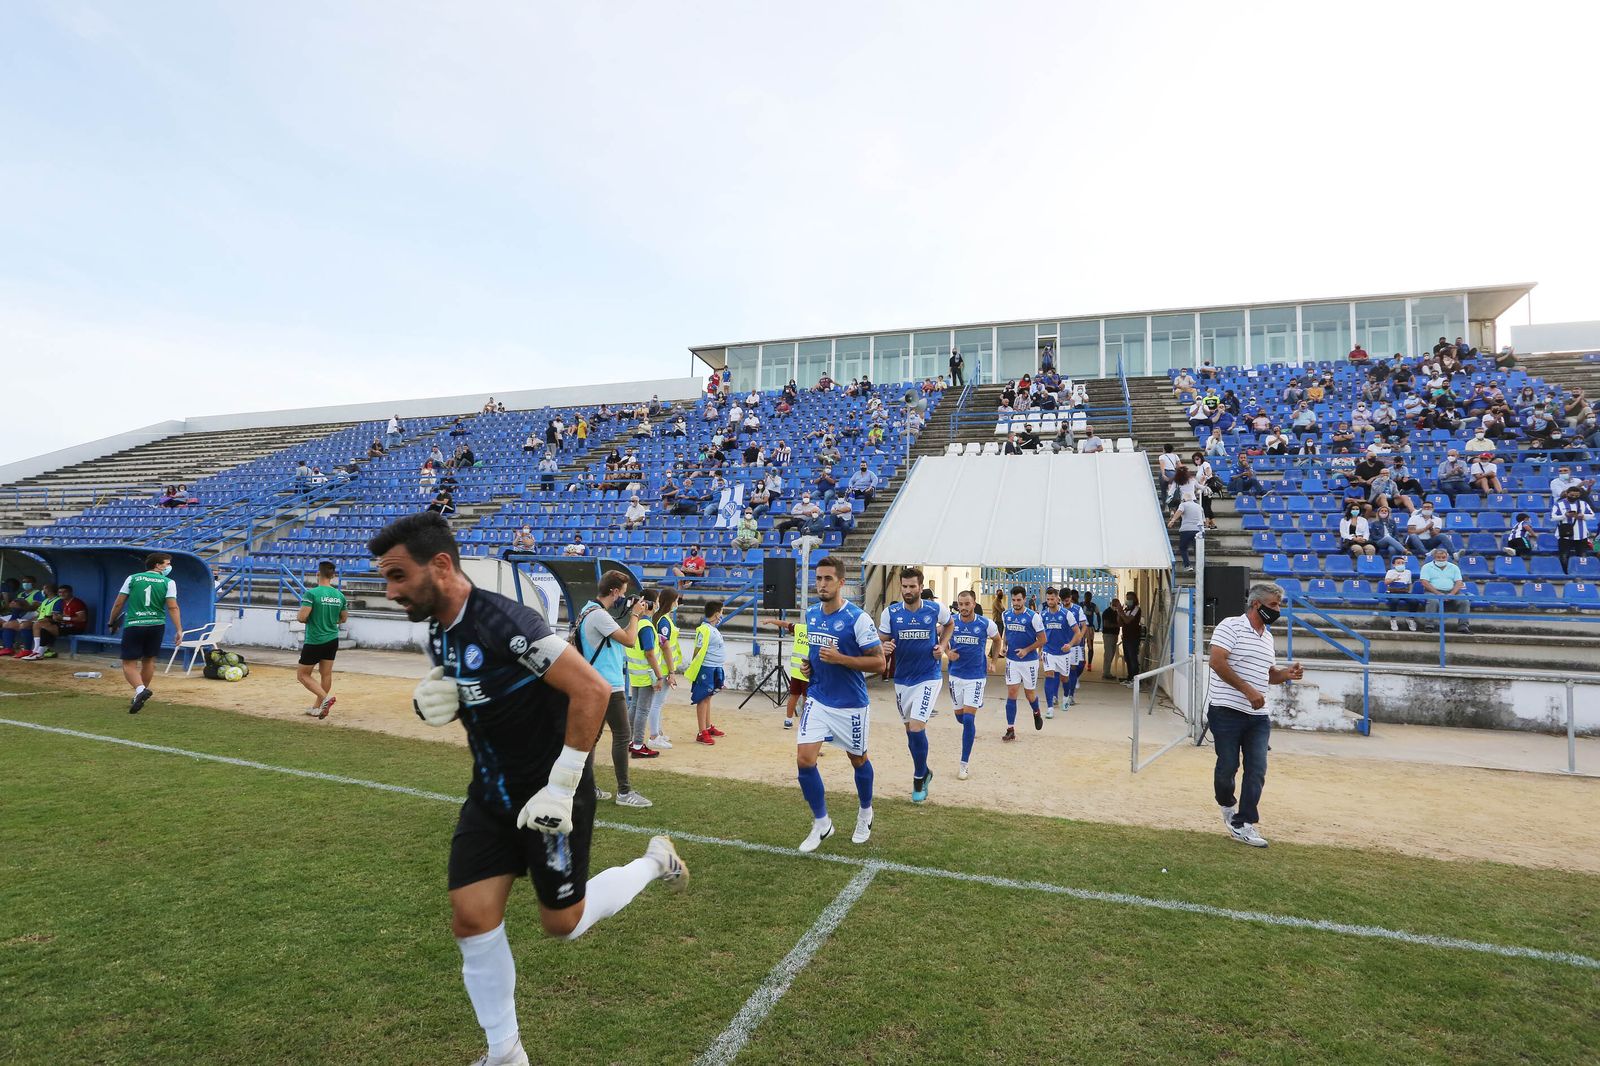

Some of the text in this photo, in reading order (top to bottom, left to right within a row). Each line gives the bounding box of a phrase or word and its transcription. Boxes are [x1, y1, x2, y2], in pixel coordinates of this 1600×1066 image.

[143, 585, 152, 607] 1
[920, 685, 932, 711] XEREZ
[851, 714, 862, 747] XEREZ
